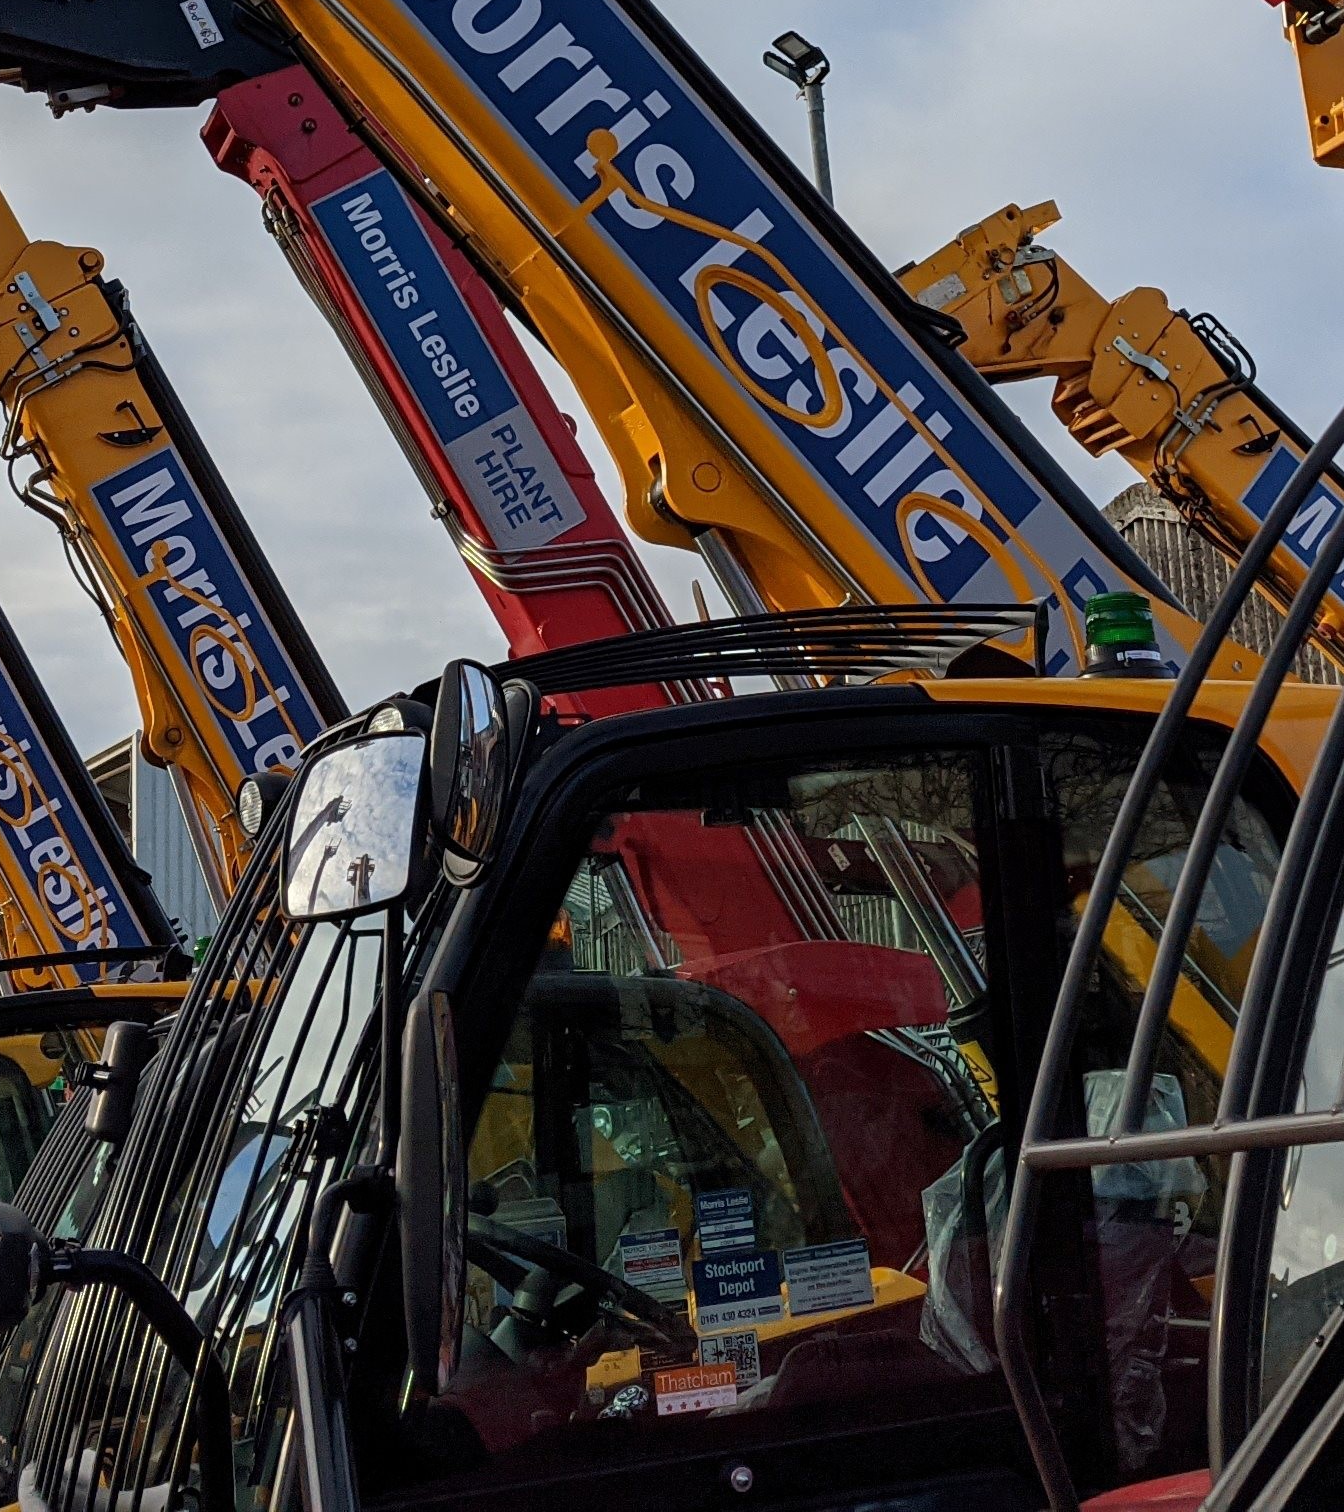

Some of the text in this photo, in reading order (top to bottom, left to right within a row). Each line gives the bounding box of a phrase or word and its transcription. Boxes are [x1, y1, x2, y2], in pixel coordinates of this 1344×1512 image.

[341, 191, 481, 420] Morris Leslie
[679, 208, 984, 564] Leslie
[474, 449, 532, 530] HIRE
[490, 423, 564, 527] PLANT
[110, 467, 256, 690] Morris
[705, 1257, 766, 1279] Stockport
[719, 1278, 756, 1298] Depot
[658, 1369, 733, 1392] Thatcham
